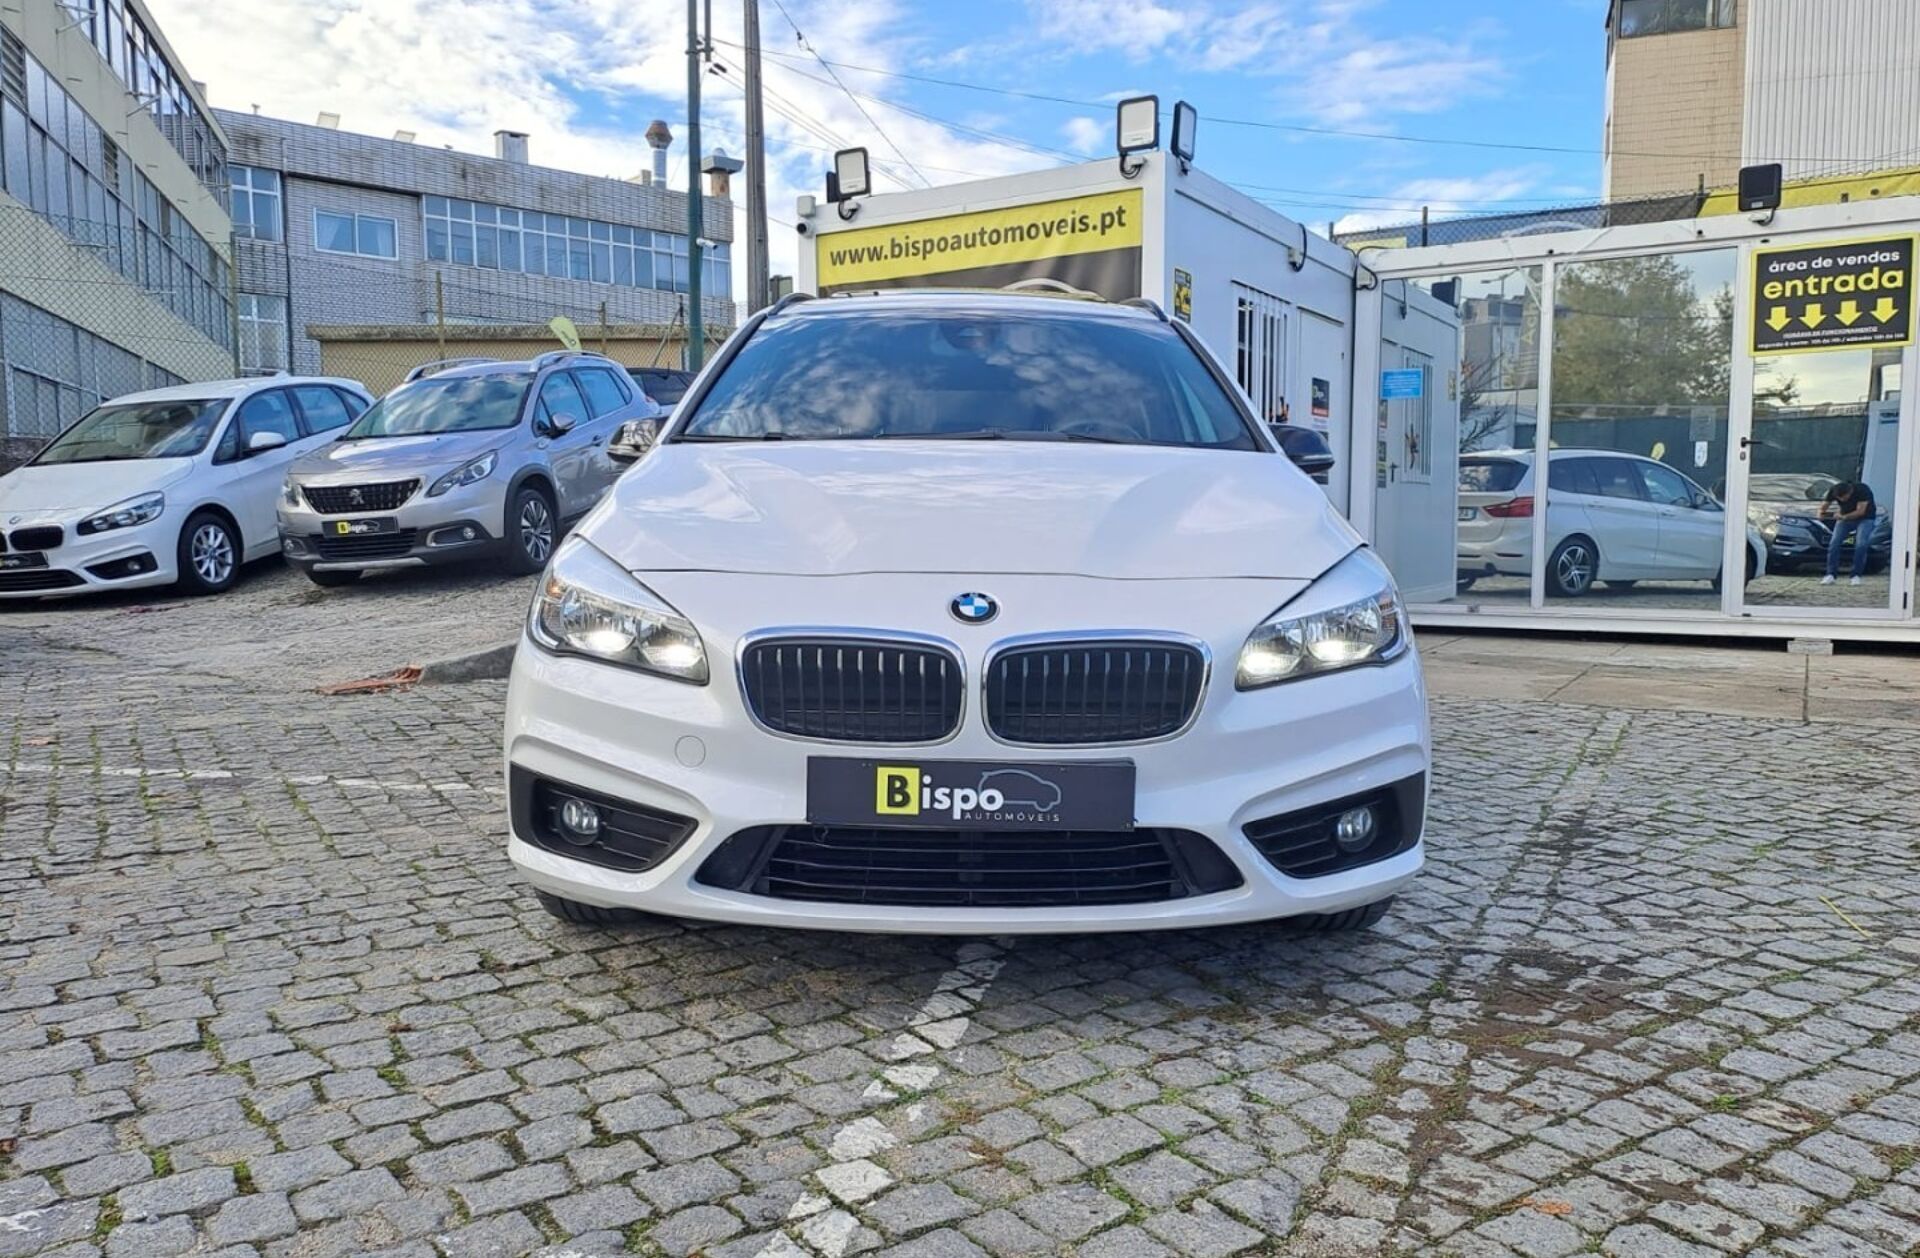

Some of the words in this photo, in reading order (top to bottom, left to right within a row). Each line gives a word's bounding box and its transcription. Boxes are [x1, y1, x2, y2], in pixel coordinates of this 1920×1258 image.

[830, 205, 1127, 267] www.bispoautomoveis.pt
[1768, 260, 1808, 273] área
[1811, 256, 1833, 269] de
[1837, 250, 1901, 267] vendas
[1763, 266, 1905, 300] entrada
[886, 773, 1005, 821] Bispo
[964, 811, 1060, 822] AUTOMÓVEIS
